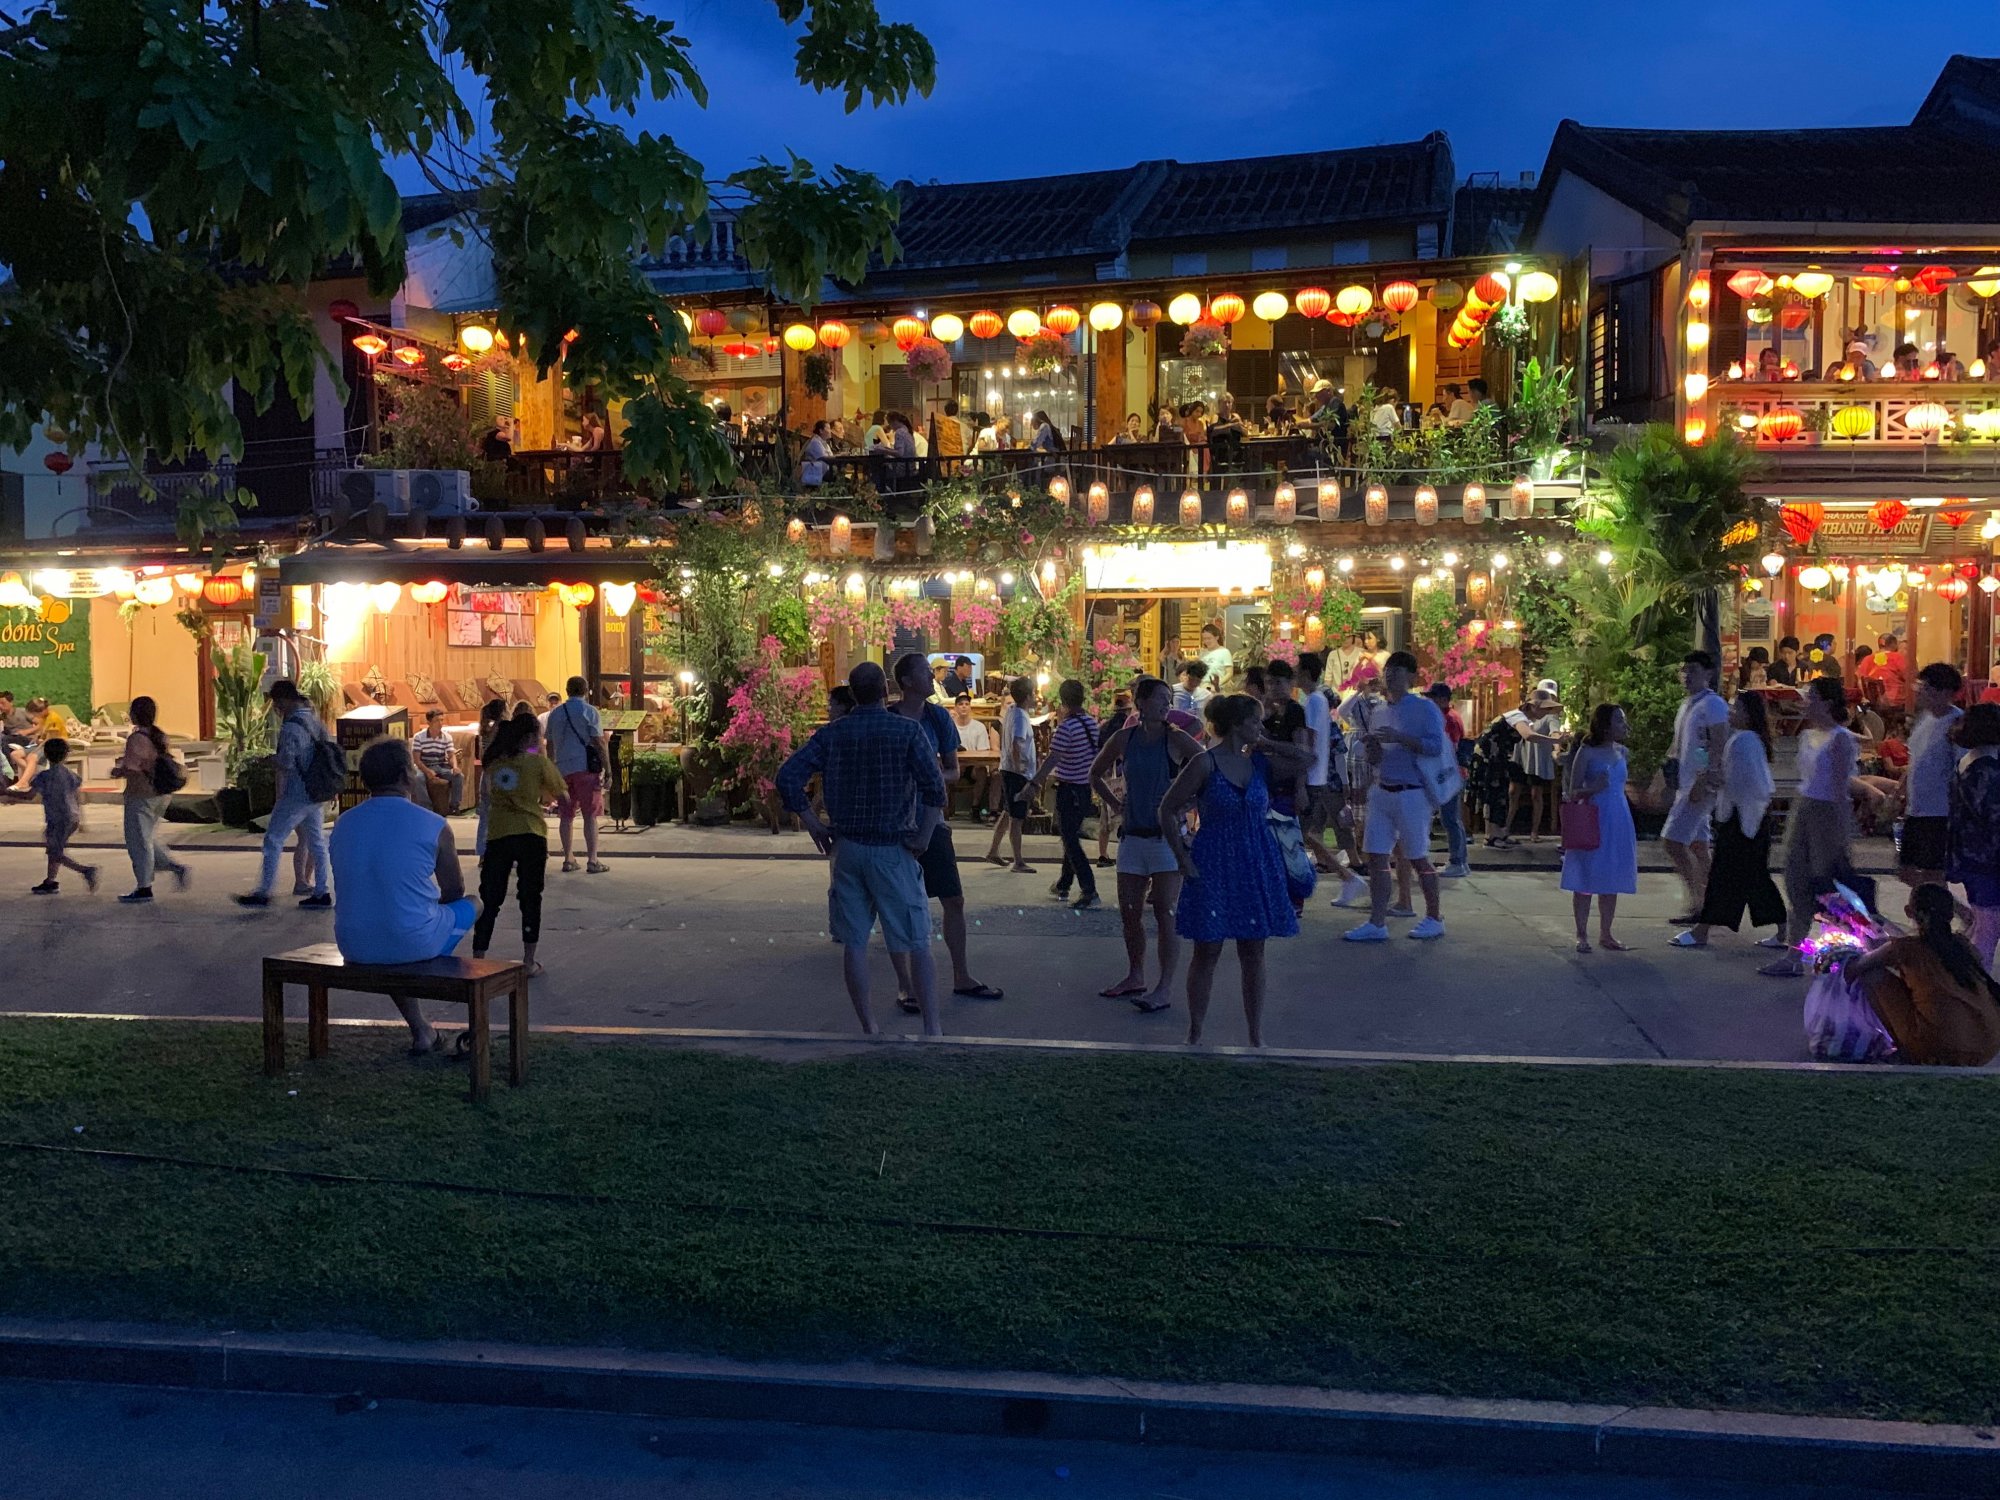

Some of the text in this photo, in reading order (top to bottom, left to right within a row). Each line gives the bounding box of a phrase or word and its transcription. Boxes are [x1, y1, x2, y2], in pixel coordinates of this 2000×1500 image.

[1822, 522, 1865, 535] THANH
[605, 622, 626, 633] BODY
[44, 626, 75, 659] Spa
[21, 655, 39, 668] 068
